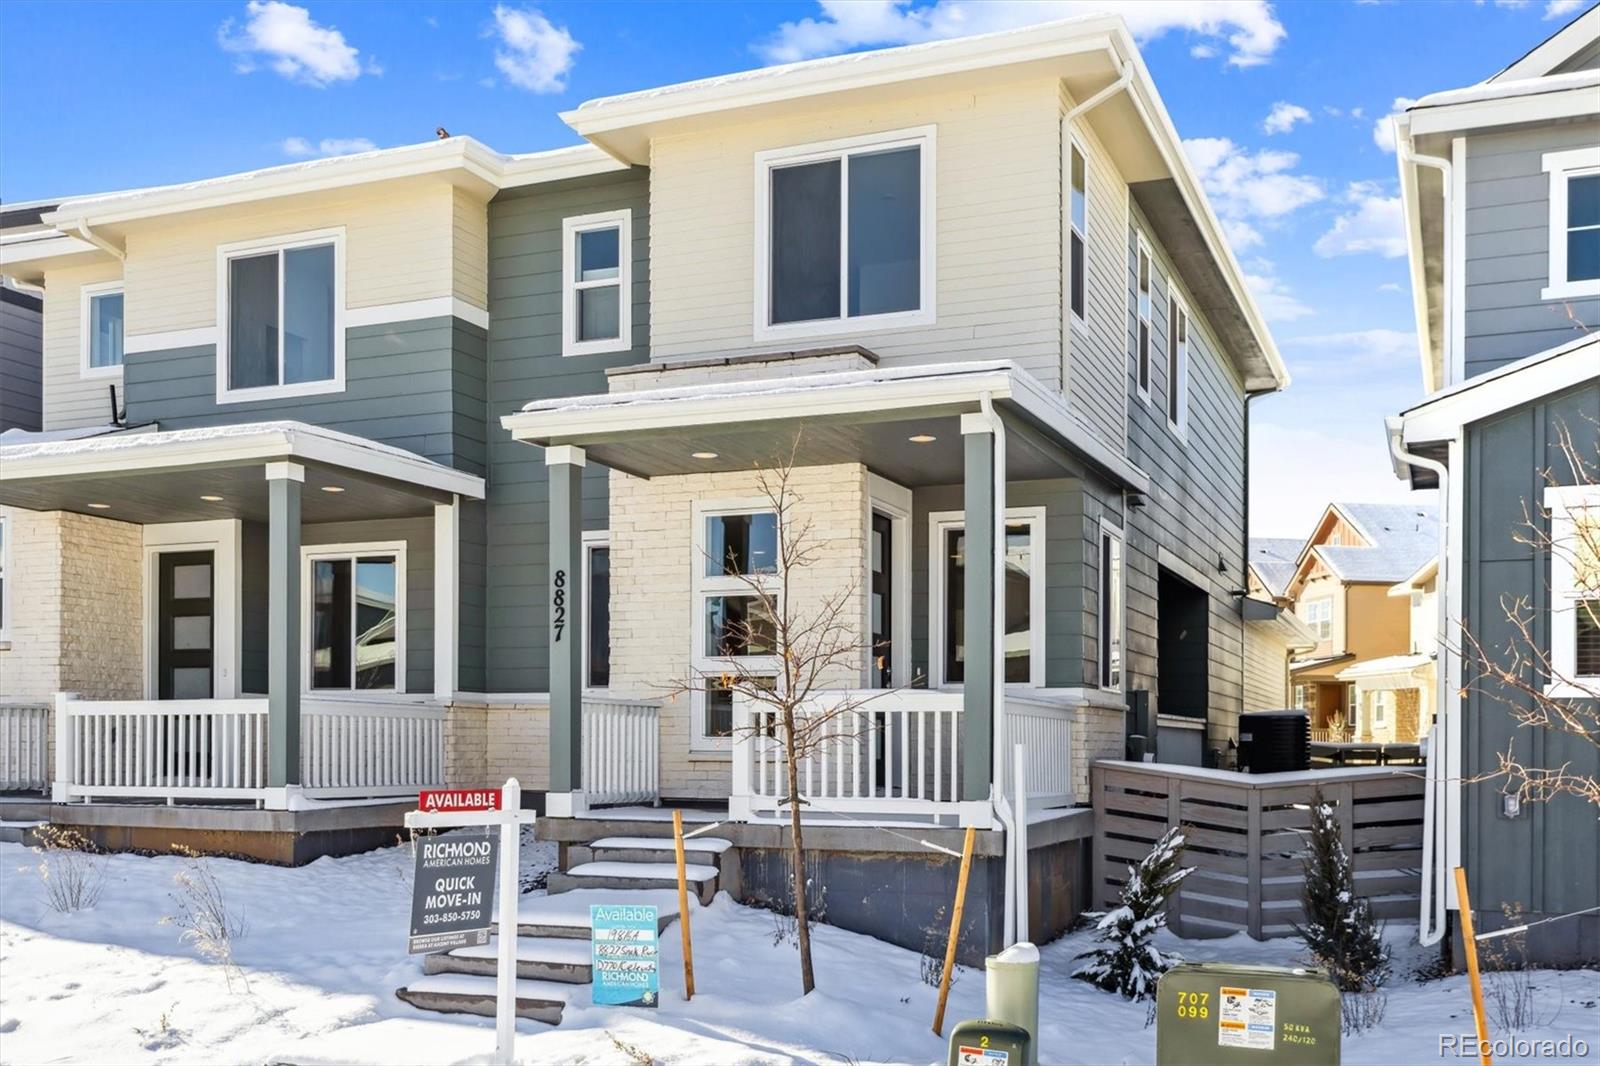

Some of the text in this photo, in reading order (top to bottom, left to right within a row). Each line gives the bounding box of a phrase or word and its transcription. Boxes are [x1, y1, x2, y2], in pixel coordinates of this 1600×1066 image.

[554, 570, 566, 642] 8827
[426, 793, 495, 808] AVAILABLE
[424, 842, 491, 858] RICHMOND
[423, 856, 490, 868] AMERICAN HOMES
[435, 876, 475, 892] QUICK
[425, 892, 482, 909] MOVE-IN
[424, 910, 480, 924] 303-850-5750
[595, 908, 654, 921] Available
[602, 972, 648, 982] RICHMOND
[1177, 991, 1210, 1005] 707
[1177, 1005, 1210, 1019] 099
[980, 1036, 989, 1048] 2
